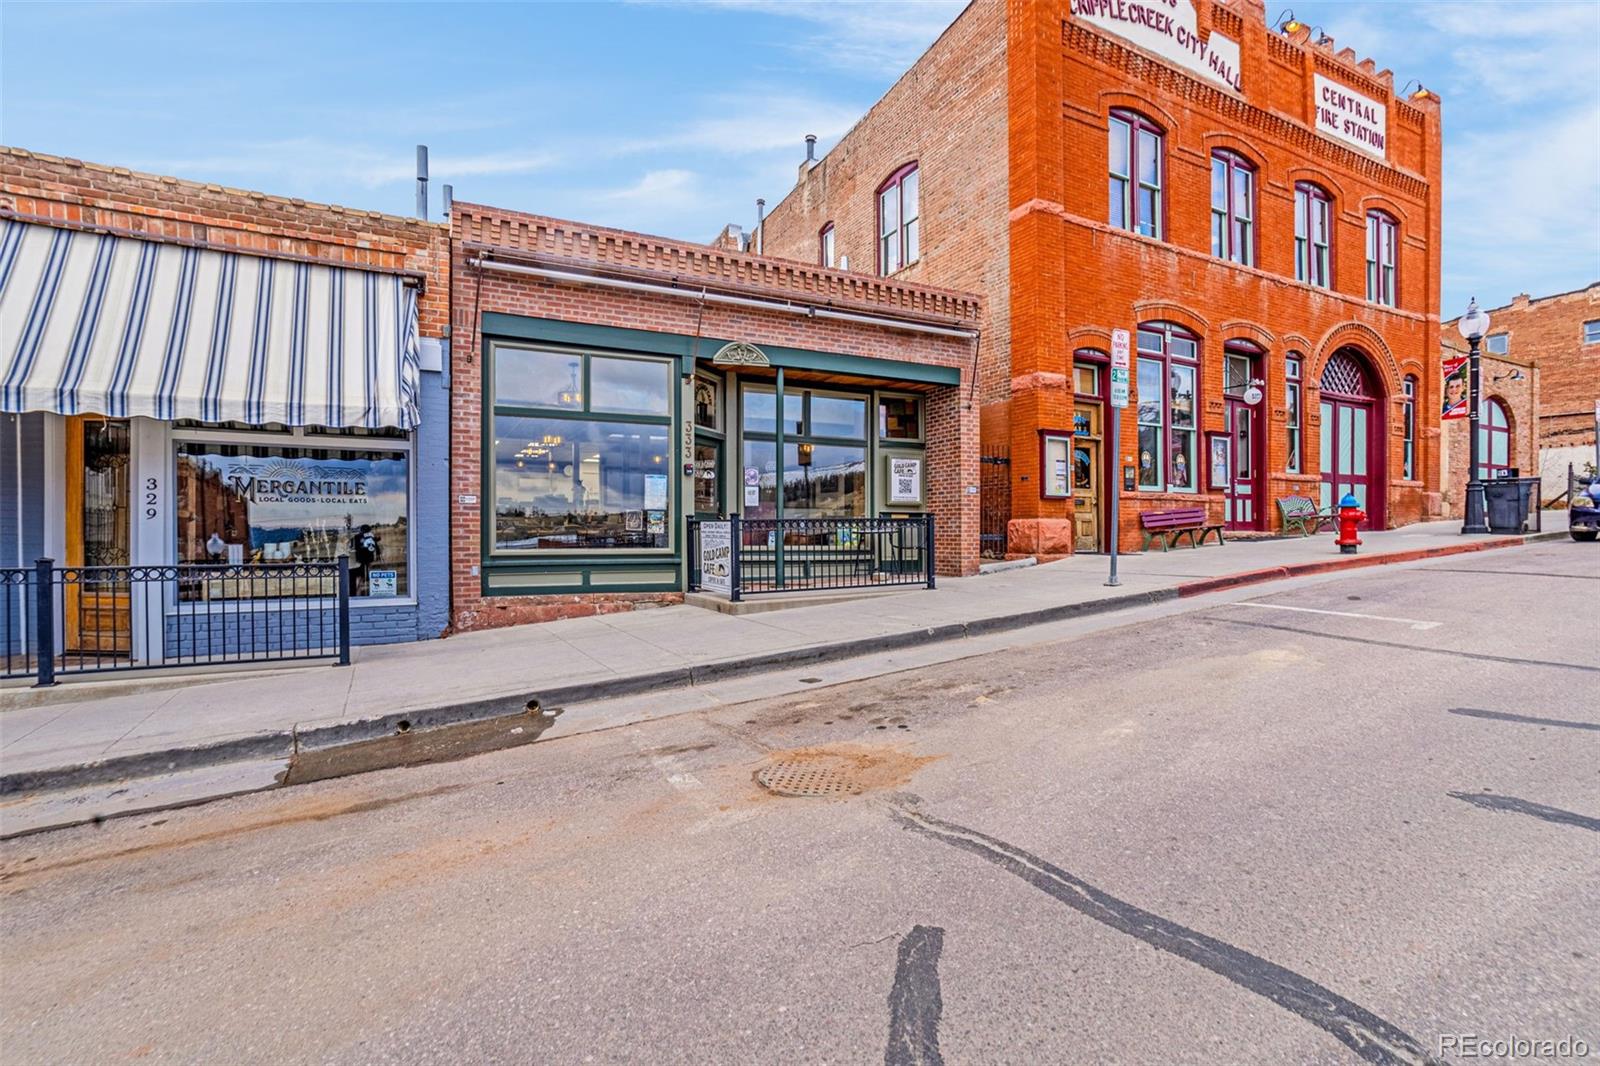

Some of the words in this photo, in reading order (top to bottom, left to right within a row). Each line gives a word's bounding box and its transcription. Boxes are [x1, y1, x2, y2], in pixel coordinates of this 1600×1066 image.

[1070, 0, 1129, 22] CRIPPLE
[1128, 3, 1175, 37] CREEK
[1177, 25, 1208, 61] CITY
[1208, 51, 1242, 92] HALL
[1322, 86, 1378, 125] CENTRAL
[1343, 119, 1385, 150] STATION
[146, 477, 158, 520] 329
[228, 475, 367, 505] MERCANTILE
[703, 549, 715, 562] GOLD
[715, 546, 730, 560] CAMP
[703, 562, 715, 575] CAFE
